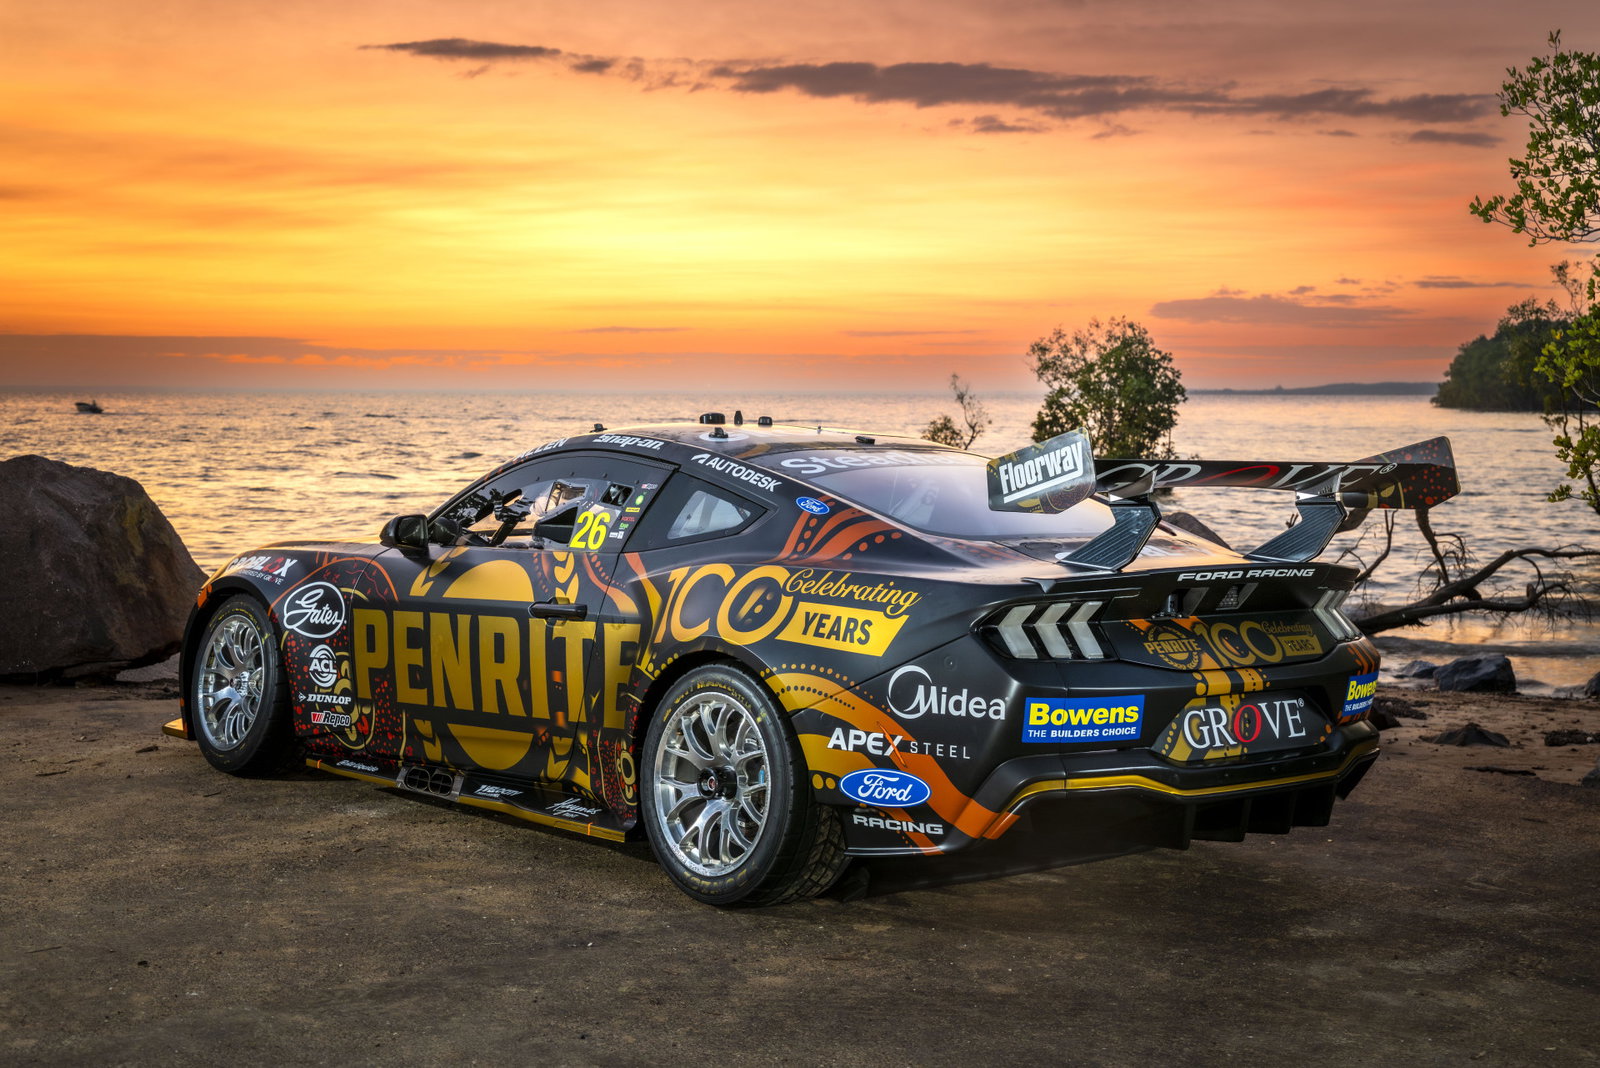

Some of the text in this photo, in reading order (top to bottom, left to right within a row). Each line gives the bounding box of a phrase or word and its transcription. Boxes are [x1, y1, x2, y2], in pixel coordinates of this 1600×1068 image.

[707, 456, 783, 492] AUTODESK
[998, 440, 1083, 489] Floorway
[801, 499, 824, 513] Ford
[569, 511, 611, 550] 26
[1177, 568, 1315, 582] FORD RACING
[785, 568, 922, 616] Celebrating
[294, 588, 344, 626] Gates
[801, 611, 873, 646] YEARS
[1143, 638, 1202, 655] PENRITE
[1284, 639, 1315, 653] YEARS
[308, 657, 338, 674] ACL
[352, 608, 642, 730] PENRITE
[307, 693, 352, 706] DUNLOP
[903, 684, 1006, 721] Midea
[1346, 681, 1377, 701] Bowen
[323, 711, 350, 727] Repco
[1028, 703, 1140, 727] Bowens
[827, 727, 971, 760] APEX STEEL
[1028, 726, 1137, 738] THE BUILDERS CHOICE
[856, 773, 913, 802] Ford
[852, 814, 944, 835] RACING
